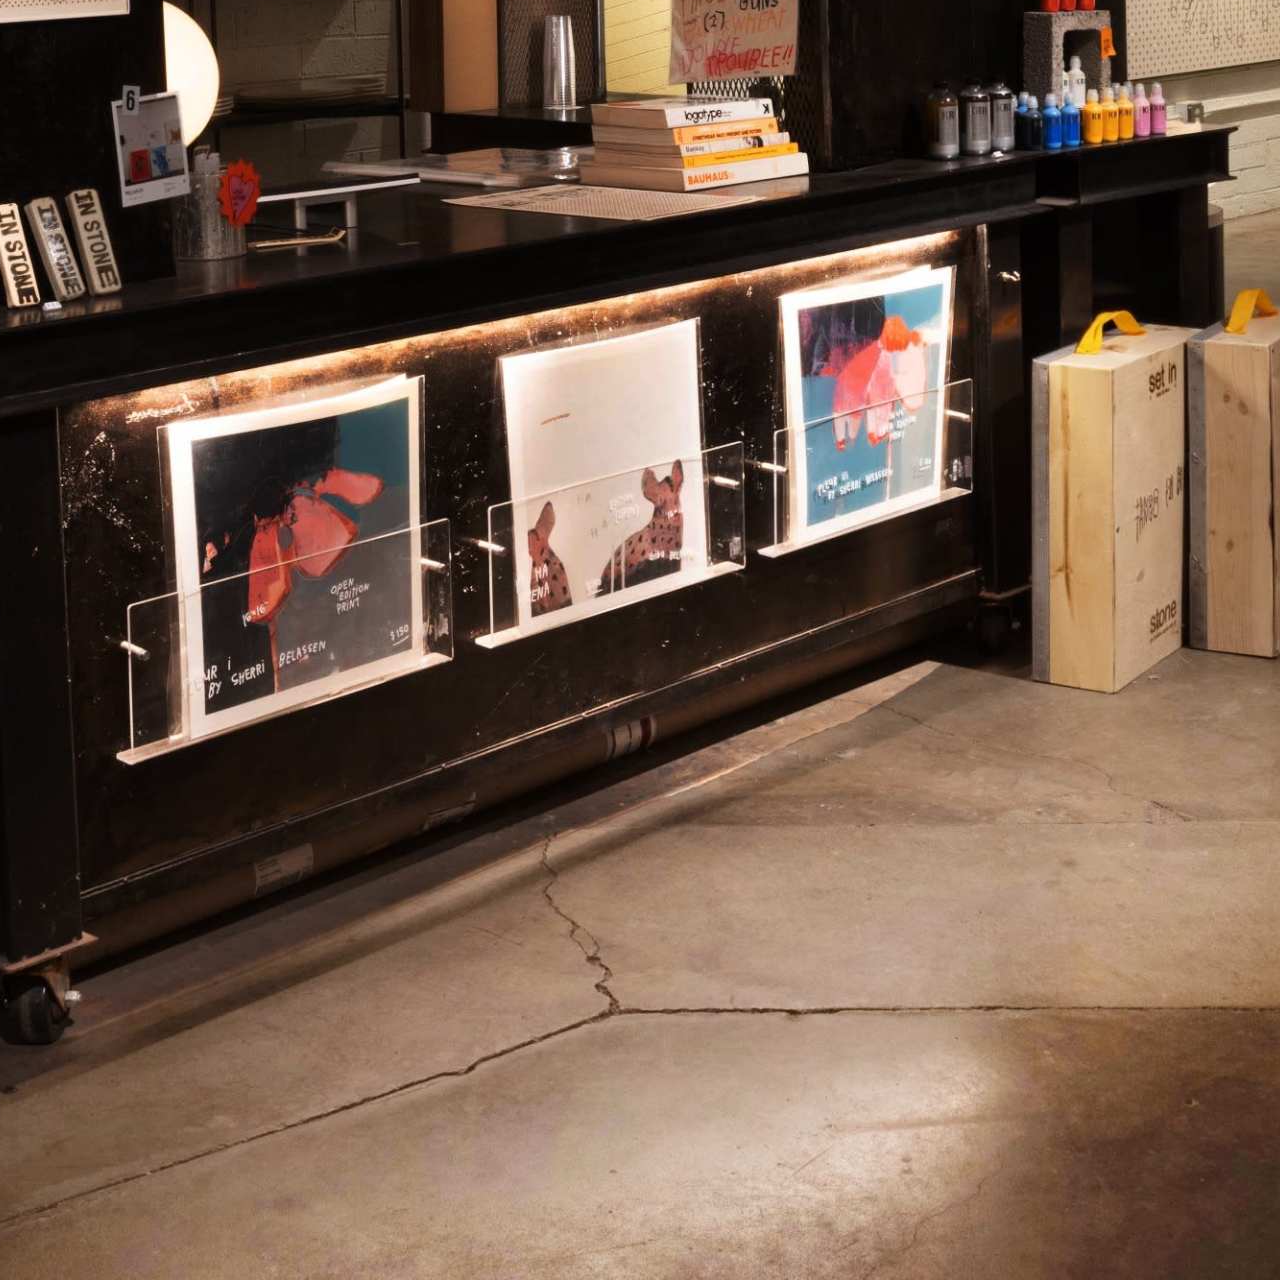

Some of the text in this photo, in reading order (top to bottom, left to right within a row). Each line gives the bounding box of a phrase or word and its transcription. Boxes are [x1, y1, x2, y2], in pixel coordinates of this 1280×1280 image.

[125, 89, 136, 111] 6
[684, 108, 722, 124] logotype
[687, 170, 729, 186] BAUHAUS
[74, 191, 118, 288] IN STONE
[5, 240, 39, 305] STONE
[1148, 361, 1177, 394] set in
[330, 577, 355, 596] OPEN
[338, 583, 371, 601] EDITION
[1149, 600, 1177, 634] stone
[208, 681, 222, 700] BY
[278, 640, 327, 668] BELASSEN
